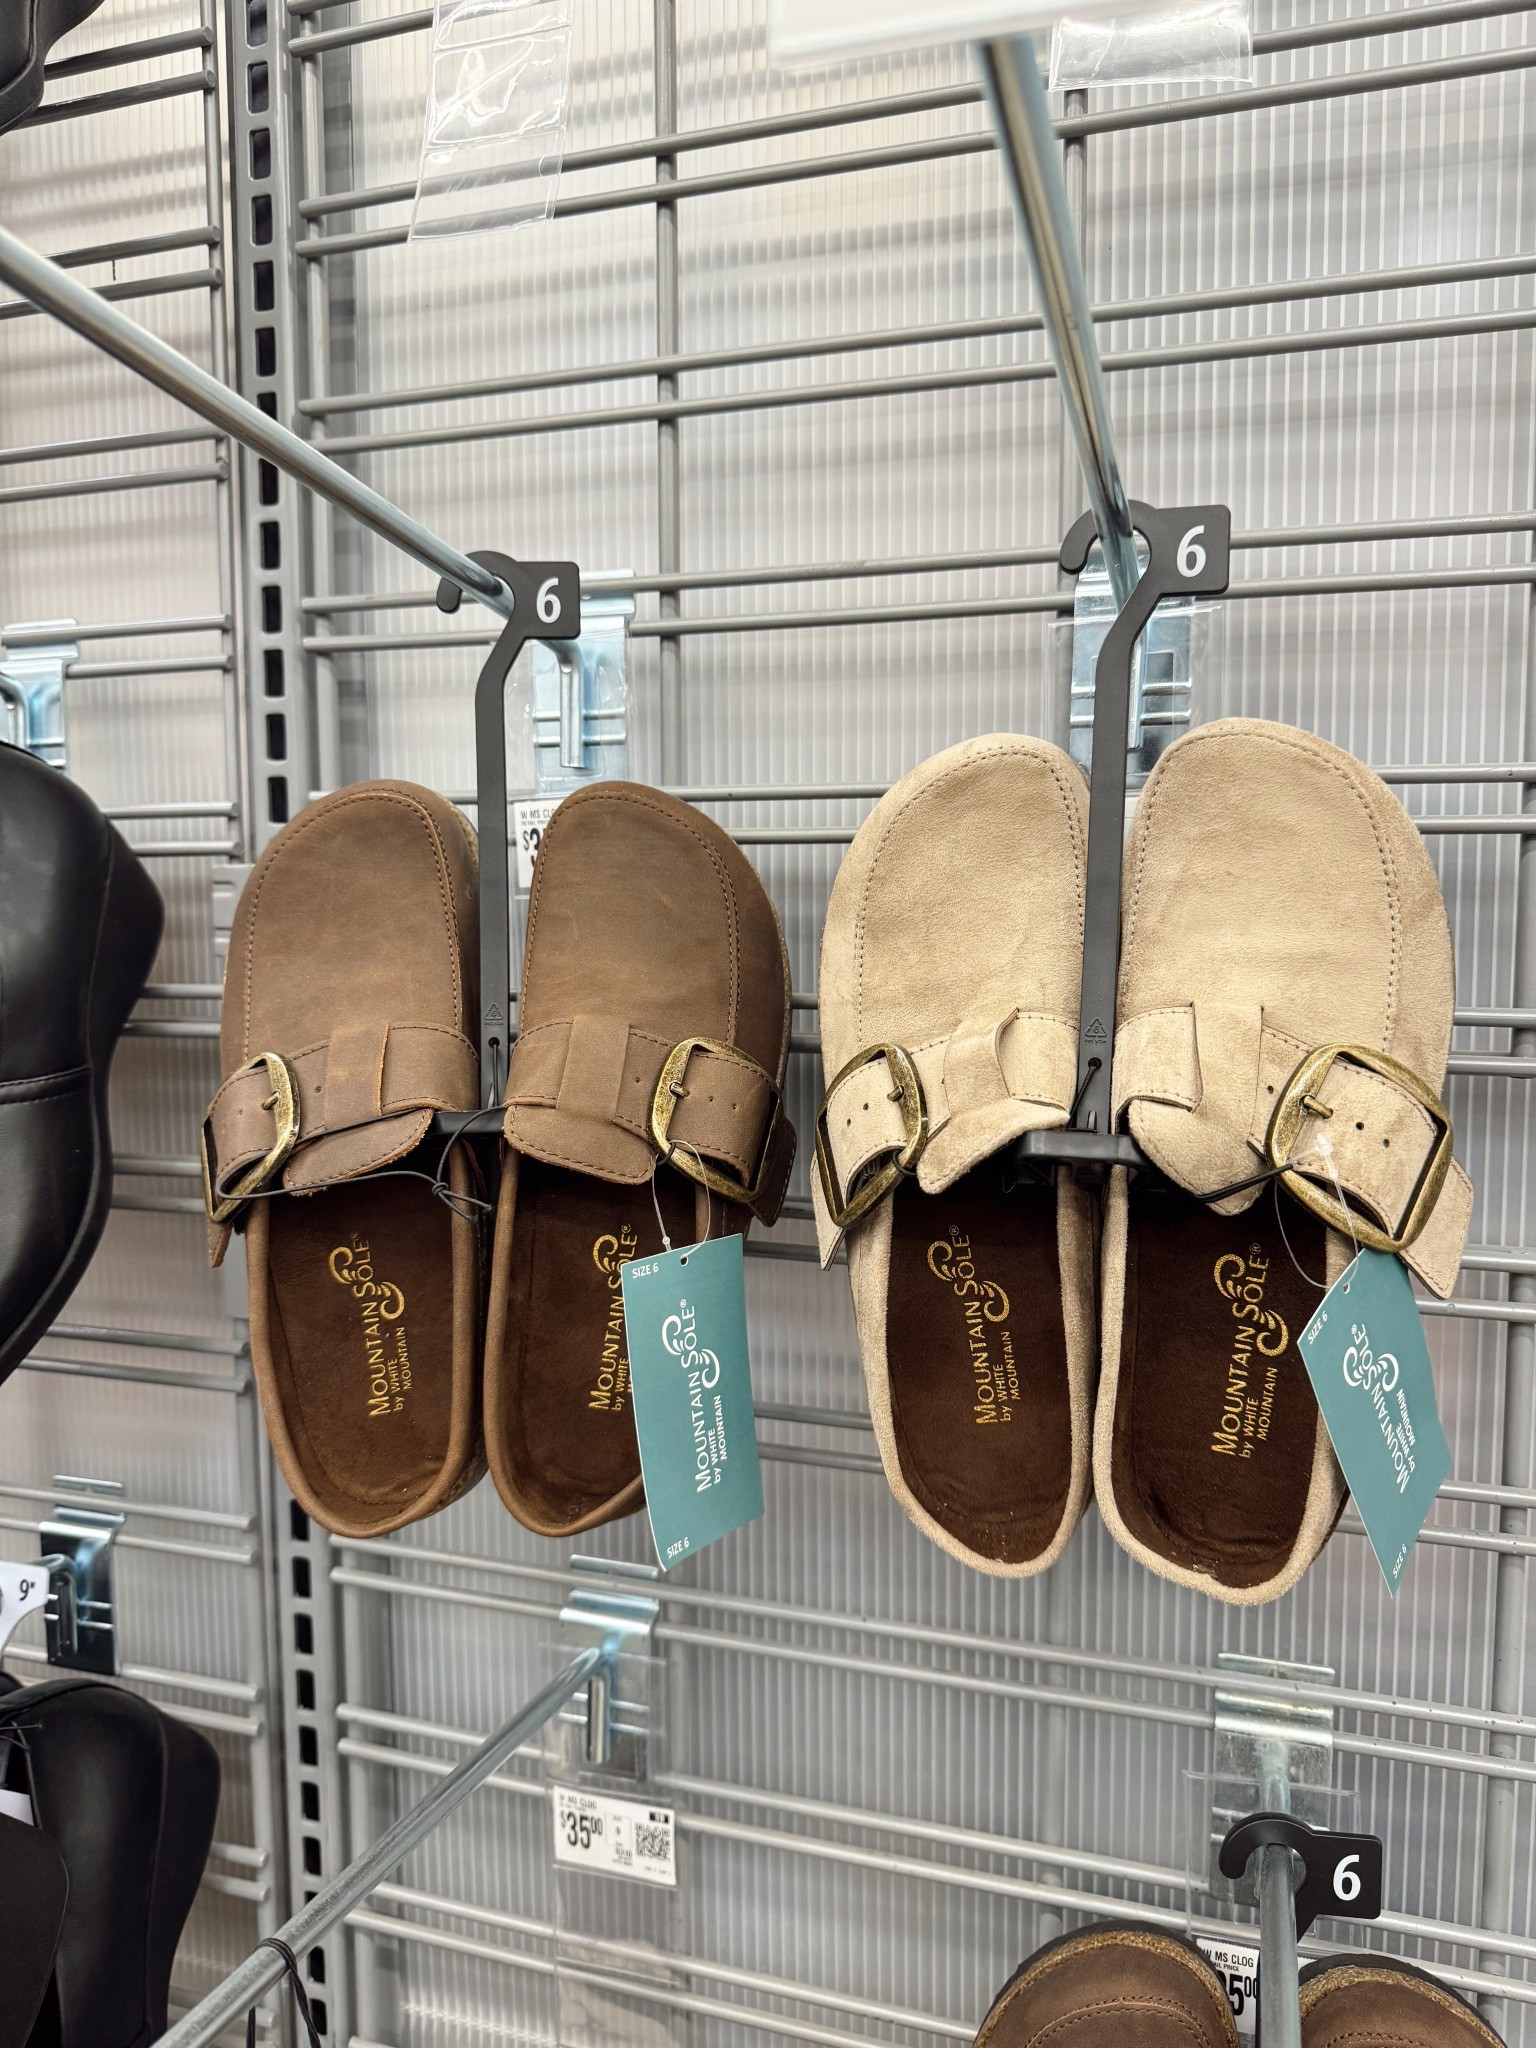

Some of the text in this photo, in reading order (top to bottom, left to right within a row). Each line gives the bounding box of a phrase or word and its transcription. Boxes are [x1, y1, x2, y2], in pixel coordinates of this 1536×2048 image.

[1177, 525, 1206, 578] 6
[536, 577, 561, 624] 6
[520, 810, 528, 819] W
[530, 810, 541, 819] MS
[632, 1262, 659, 1279] SIZE 6
[588, 1295, 625, 1411] MOUNTAIN
[1307, 1310, 1328, 1345] SIZE 6
[361, 1301, 391, 1416] MOUNTAIN
[388, 1358, 405, 1412] by WHITE
[395, 1326, 412, 1390] MOUNTAIN
[612, 1357, 629, 1411] by WHITE
[964, 1301, 998, 1425] MOUNTAIN
[1001, 1331, 1020, 1400] MOUNTAIN
[993, 1363, 1013, 1421] by WHITE
[1211, 1325, 1257, 1456] MOUNTAIN
[1257, 1367, 1279, 1441] MOUNTAIN
[1396, 1388, 1416, 1446] MOUNTAIN
[688, 1371, 713, 1493] MOUNTAIN
[714, 1394, 728, 1460] MOUNTAIN
[1239, 1396, 1259, 1459] by WHITE
[1371, 1382, 1410, 1494] MOUNTAIN
[1396, 1422, 1416, 1473] by WHITE
[708, 1428, 722, 1485] by WHITE
[667, 1536, 690, 1559] SIZE 6
[1392, 1543, 1407, 1579] SIZE 6
[1333, 1854, 1361, 1901] 6
[1215, 1951, 1228, 1963] MS
[1231, 1954, 1254, 1968] CLOG
[1223, 1963, 1240, 1972] PRICE
